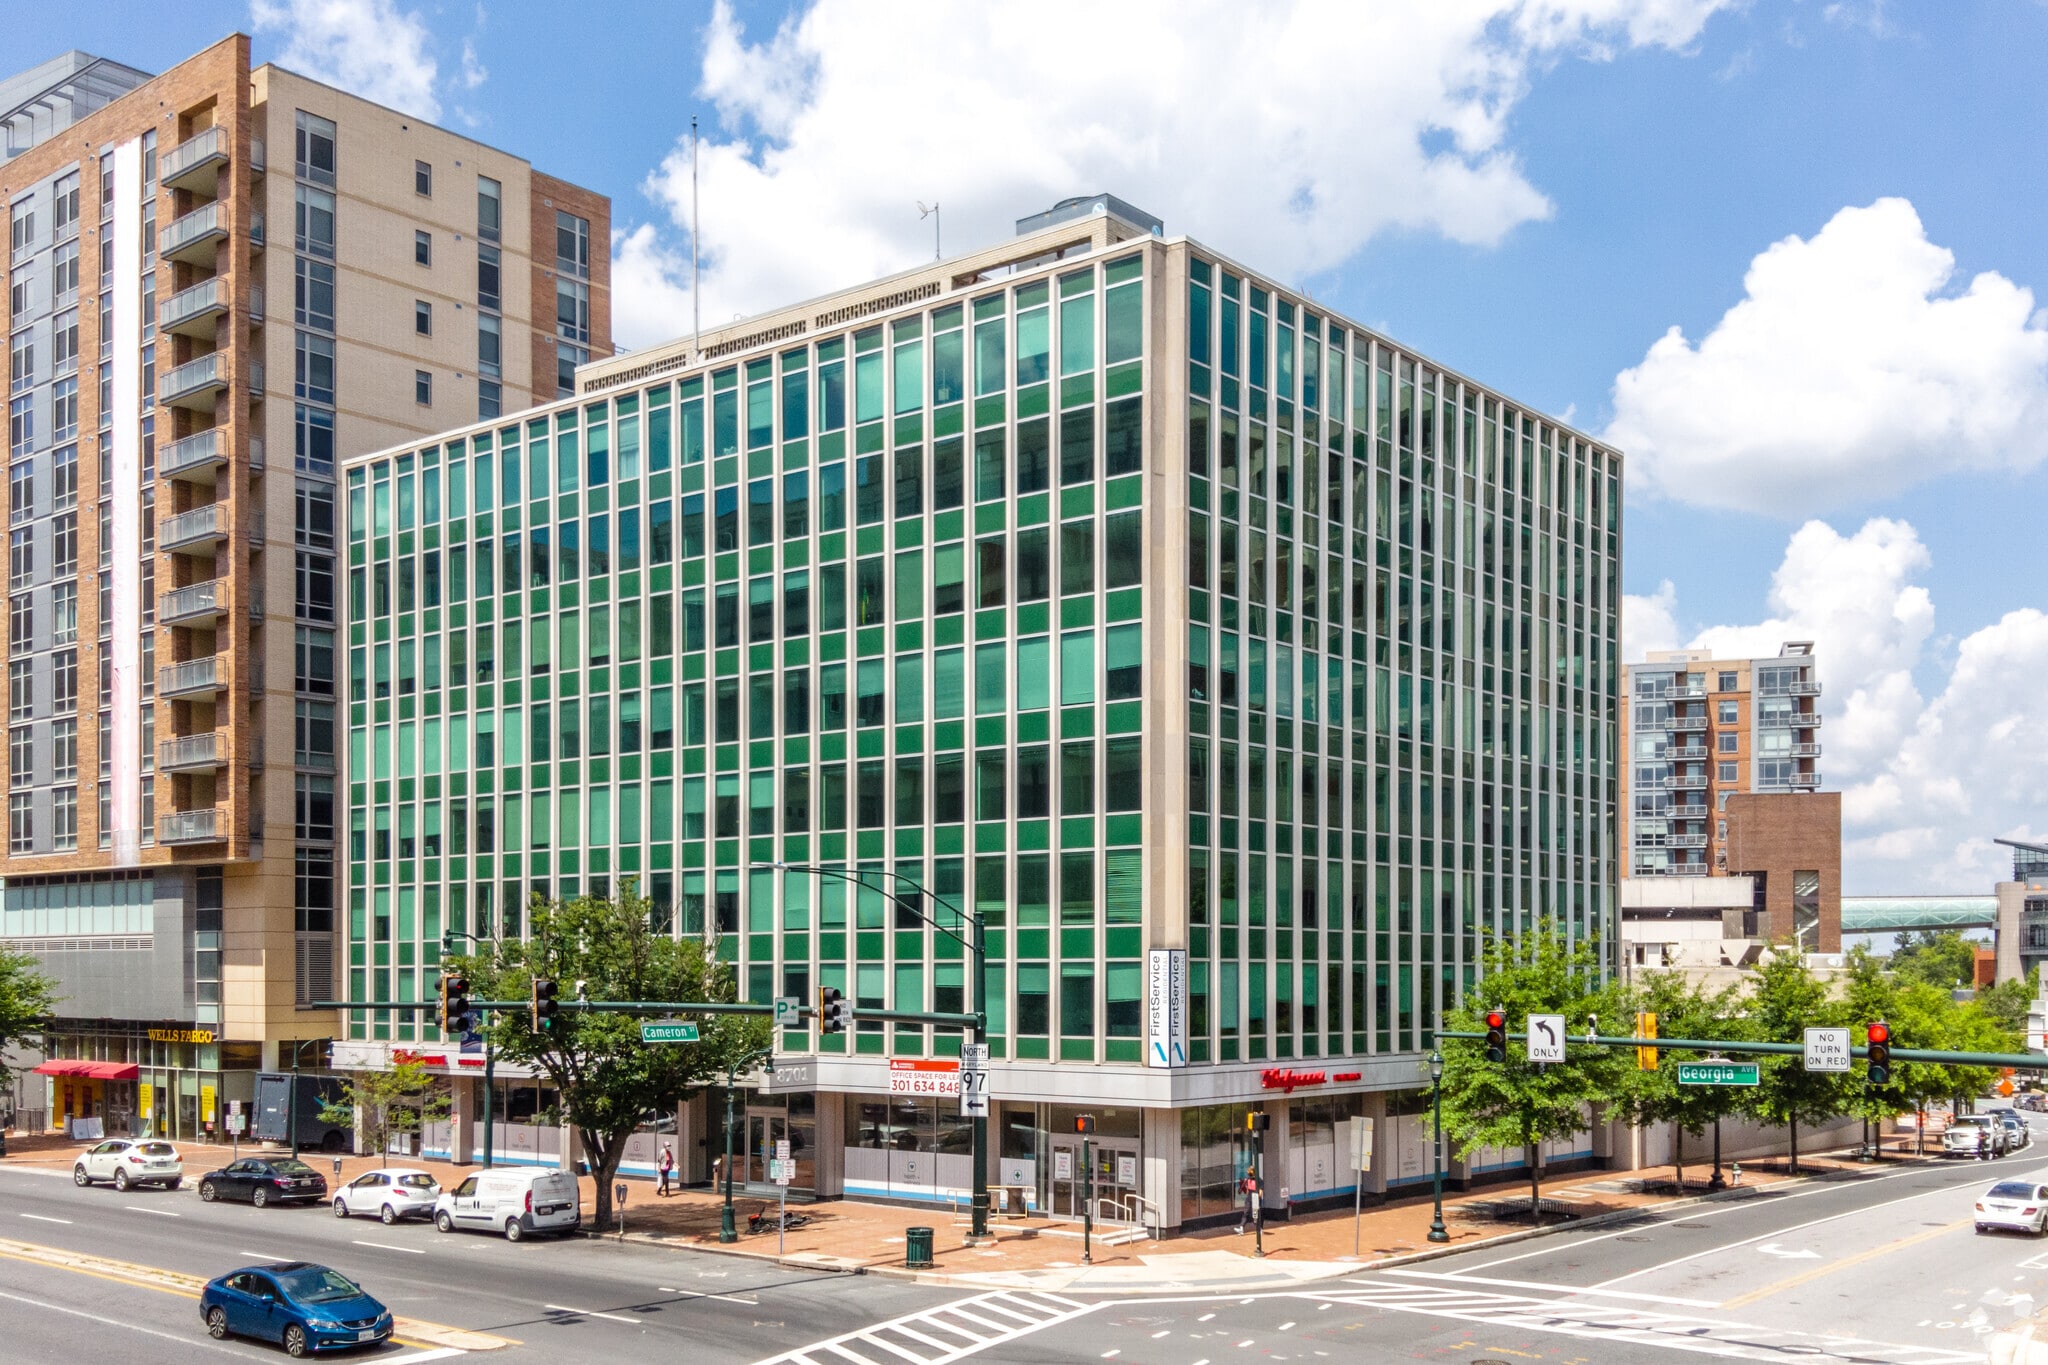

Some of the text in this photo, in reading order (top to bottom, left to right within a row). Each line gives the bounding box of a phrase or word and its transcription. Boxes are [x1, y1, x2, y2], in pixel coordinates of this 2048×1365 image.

[1150, 955, 1161, 1037] FirstService
[1171, 955, 1180, 1037] FirstService
[147, 1029, 213, 1043] WELLS FARGO
[643, 1027, 688, 1038] Cameron
[1819, 1034, 1835, 1042] NO
[963, 1046, 987, 1057] NORTH
[1533, 1047, 1559, 1057] ONLY
[1814, 1045, 1841, 1054] TURN
[1808, 1056, 1847, 1066] ON RED
[776, 1066, 809, 1083] 8701
[891, 1071, 913, 1079] OFFICE
[913, 1072, 933, 1080] SPACE
[1681, 1066, 1734, 1083] Georgia
[891, 1079, 960, 1094] 301 634 848
[963, 1072, 987, 1092] 97
